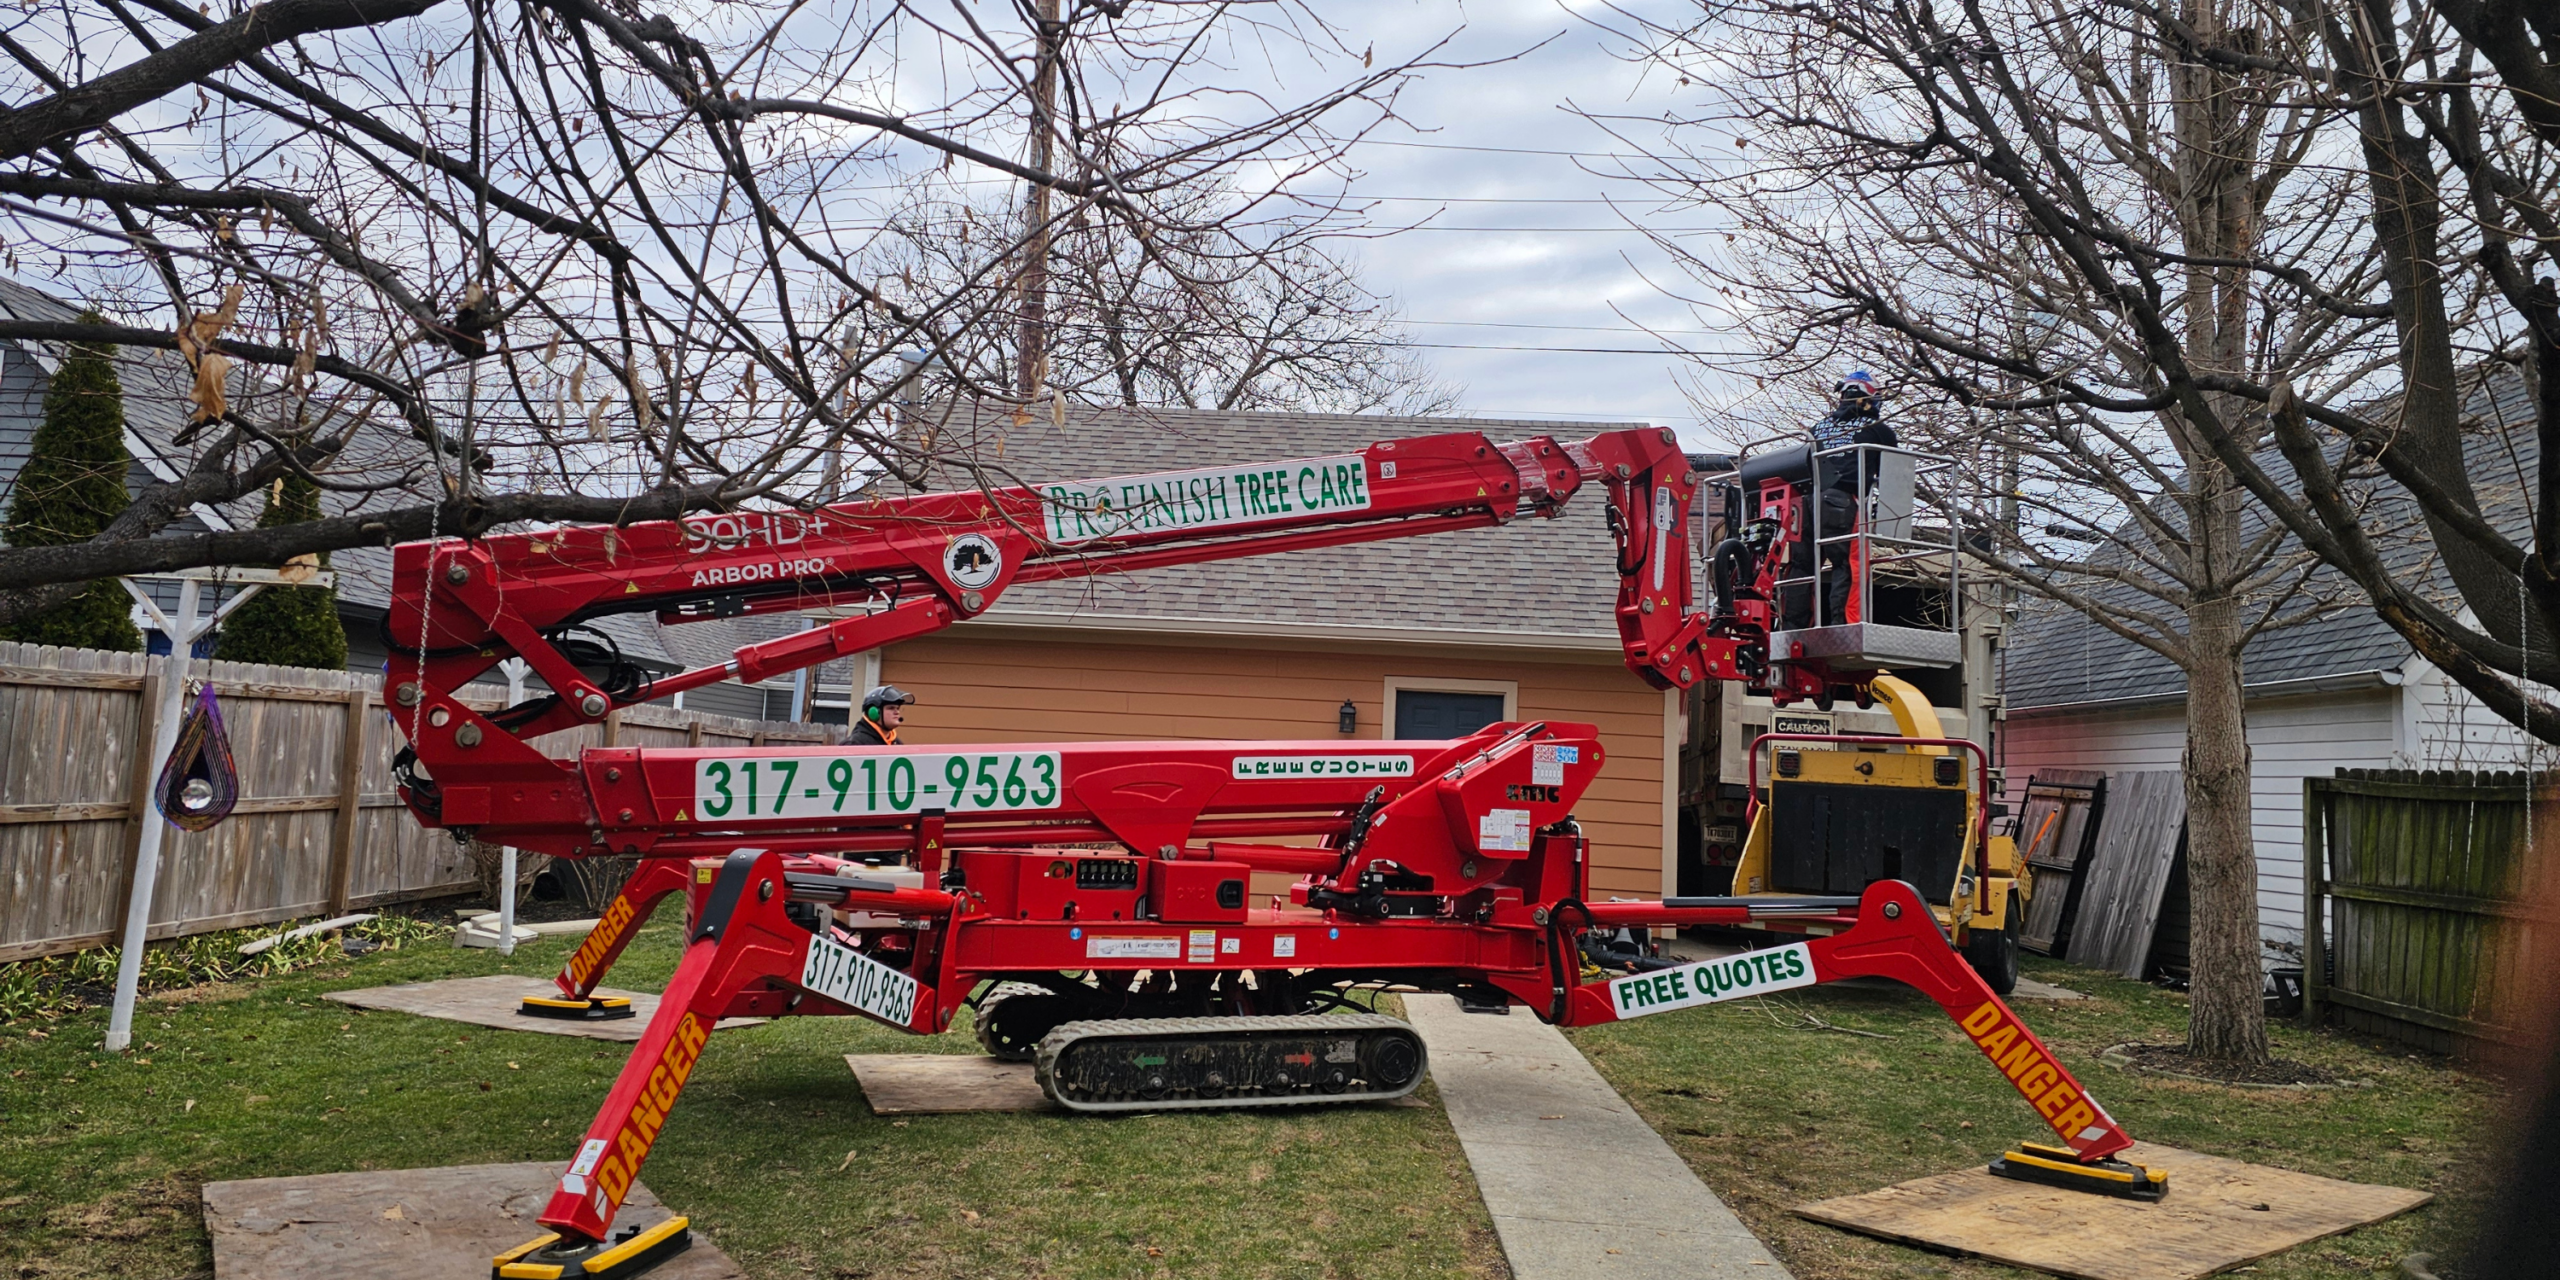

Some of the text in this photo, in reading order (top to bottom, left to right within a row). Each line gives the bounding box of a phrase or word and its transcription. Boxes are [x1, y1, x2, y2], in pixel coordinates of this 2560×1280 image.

[1234, 469, 1292, 517] TREE
[1298, 462, 1367, 510] CARE
[687, 512, 829, 553] 90HD+
[692, 563, 774, 587] ARBOR
[1778, 721, 1829, 734] CAUTION
[703, 754, 1056, 817] 317-910-9563
[1238, 760, 1408, 774] FREE QUOTES
[569, 894, 635, 985] DANGER
[806, 939, 914, 1025] 317-910-9563
[1618, 949, 1805, 1010] FREE QUOTES
[1960, 1000, 2095, 1141] DANGER
[596, 1011, 707, 1208] DANGER
